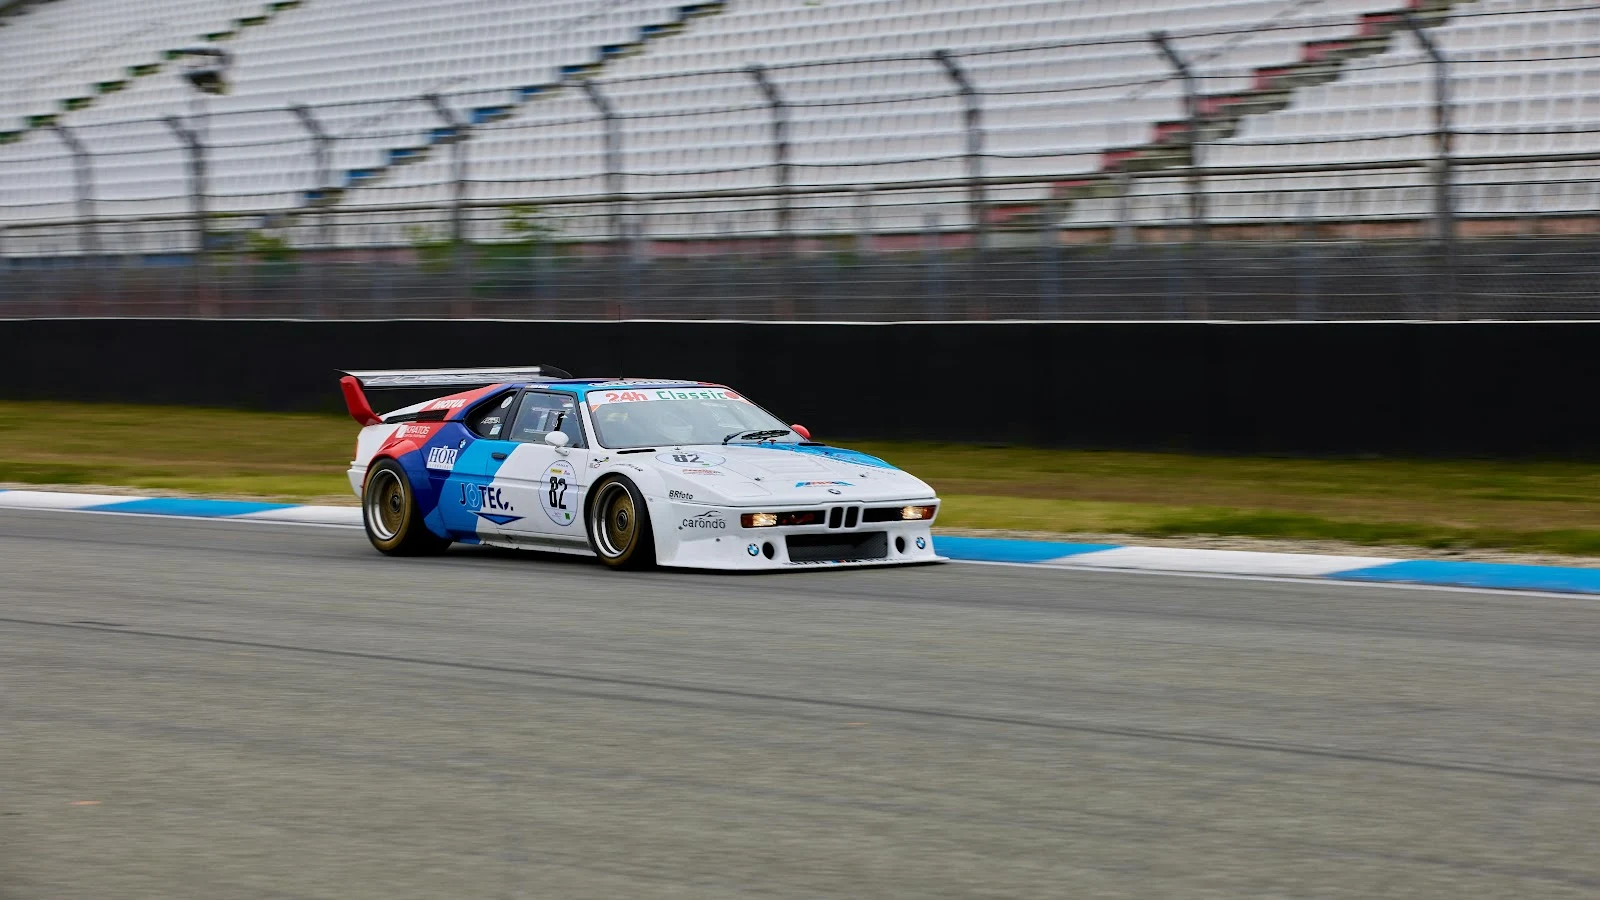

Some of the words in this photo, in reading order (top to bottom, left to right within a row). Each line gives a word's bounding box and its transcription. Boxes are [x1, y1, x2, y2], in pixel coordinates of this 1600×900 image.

[605, 391, 648, 402] 24h
[656, 390, 724, 401] Classic
[431, 398, 467, 410] MOTUL
[405, 425, 431, 435] KRATOS
[428, 446, 456, 465] HÖR
[672, 454, 704, 464] 82
[548, 476, 568, 510] 82
